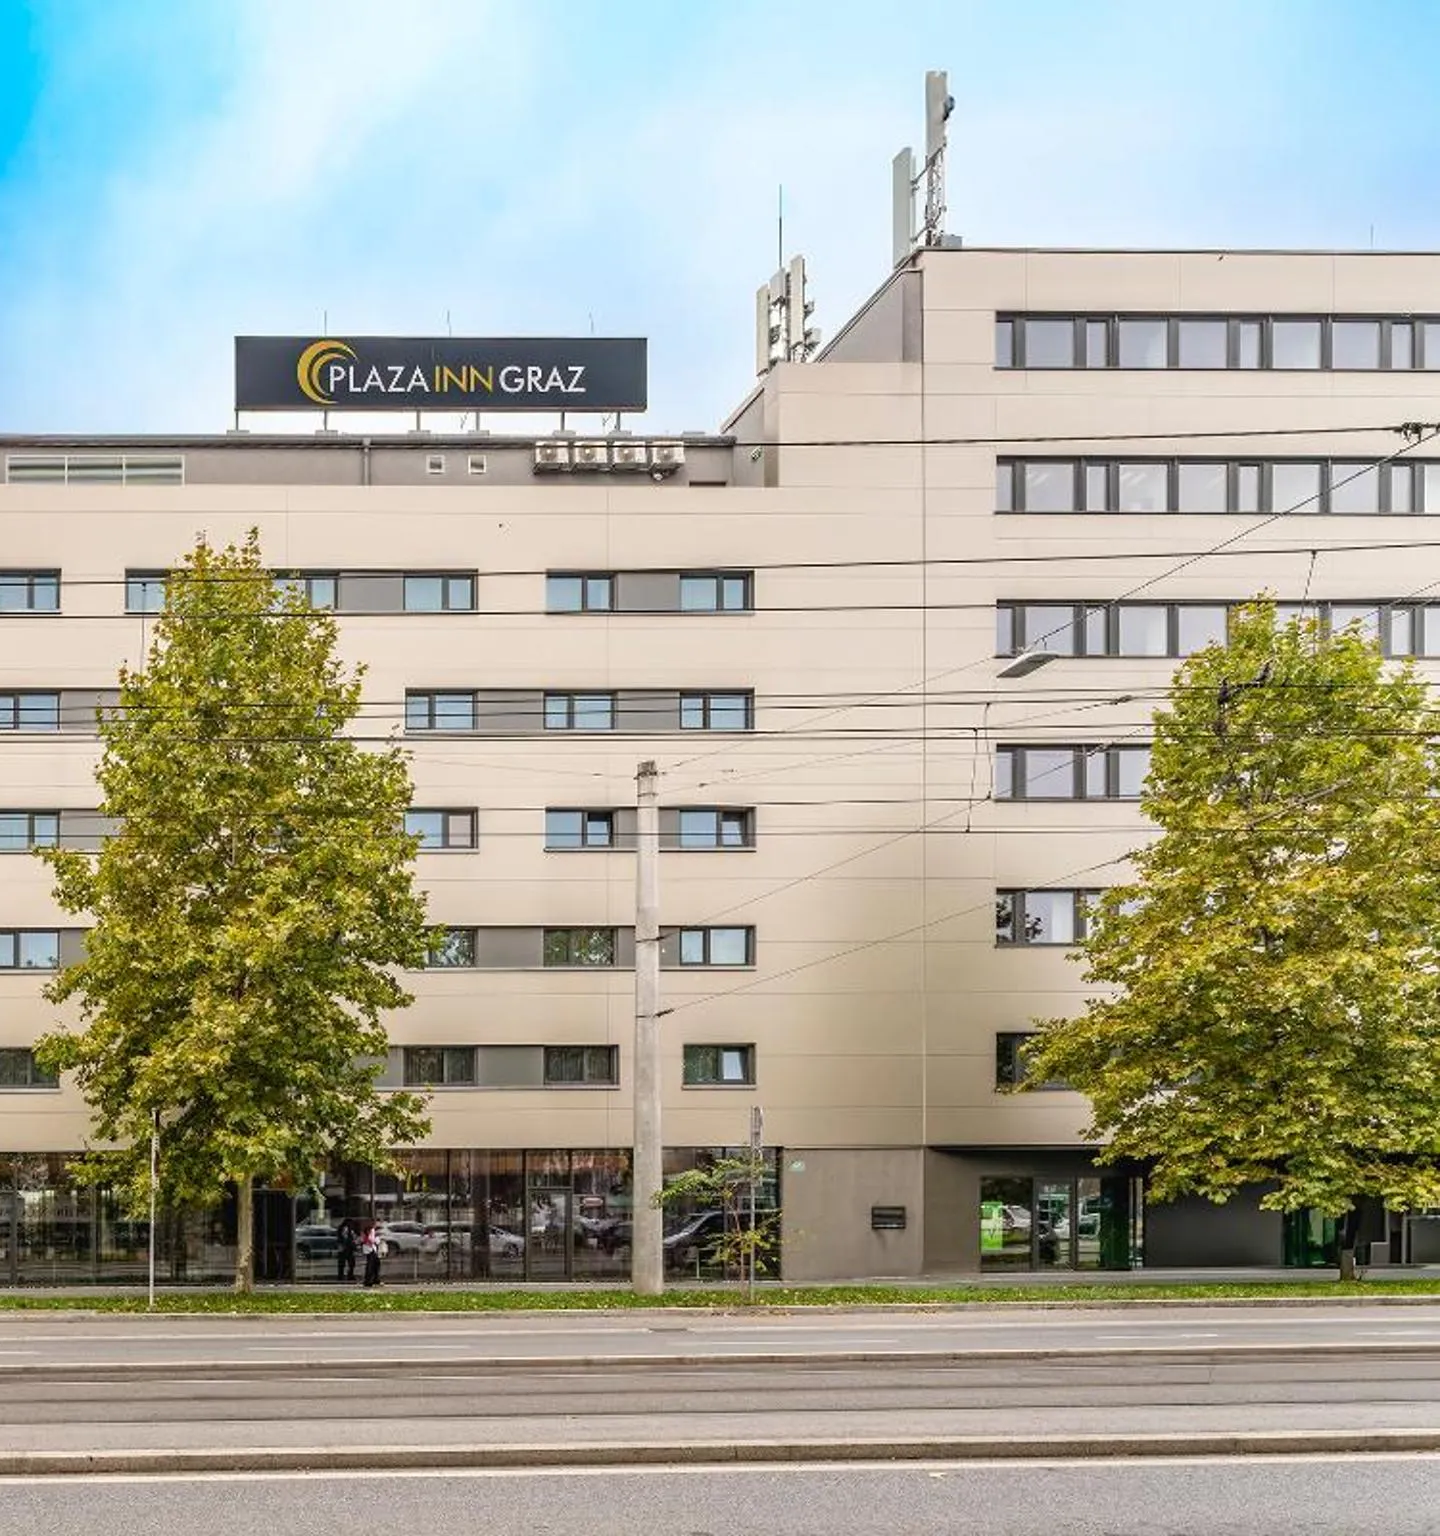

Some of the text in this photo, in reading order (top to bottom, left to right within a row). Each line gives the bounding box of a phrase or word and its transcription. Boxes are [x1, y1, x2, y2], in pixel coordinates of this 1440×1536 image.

[329, 365, 587, 393] PLAZA INN GRAZ
